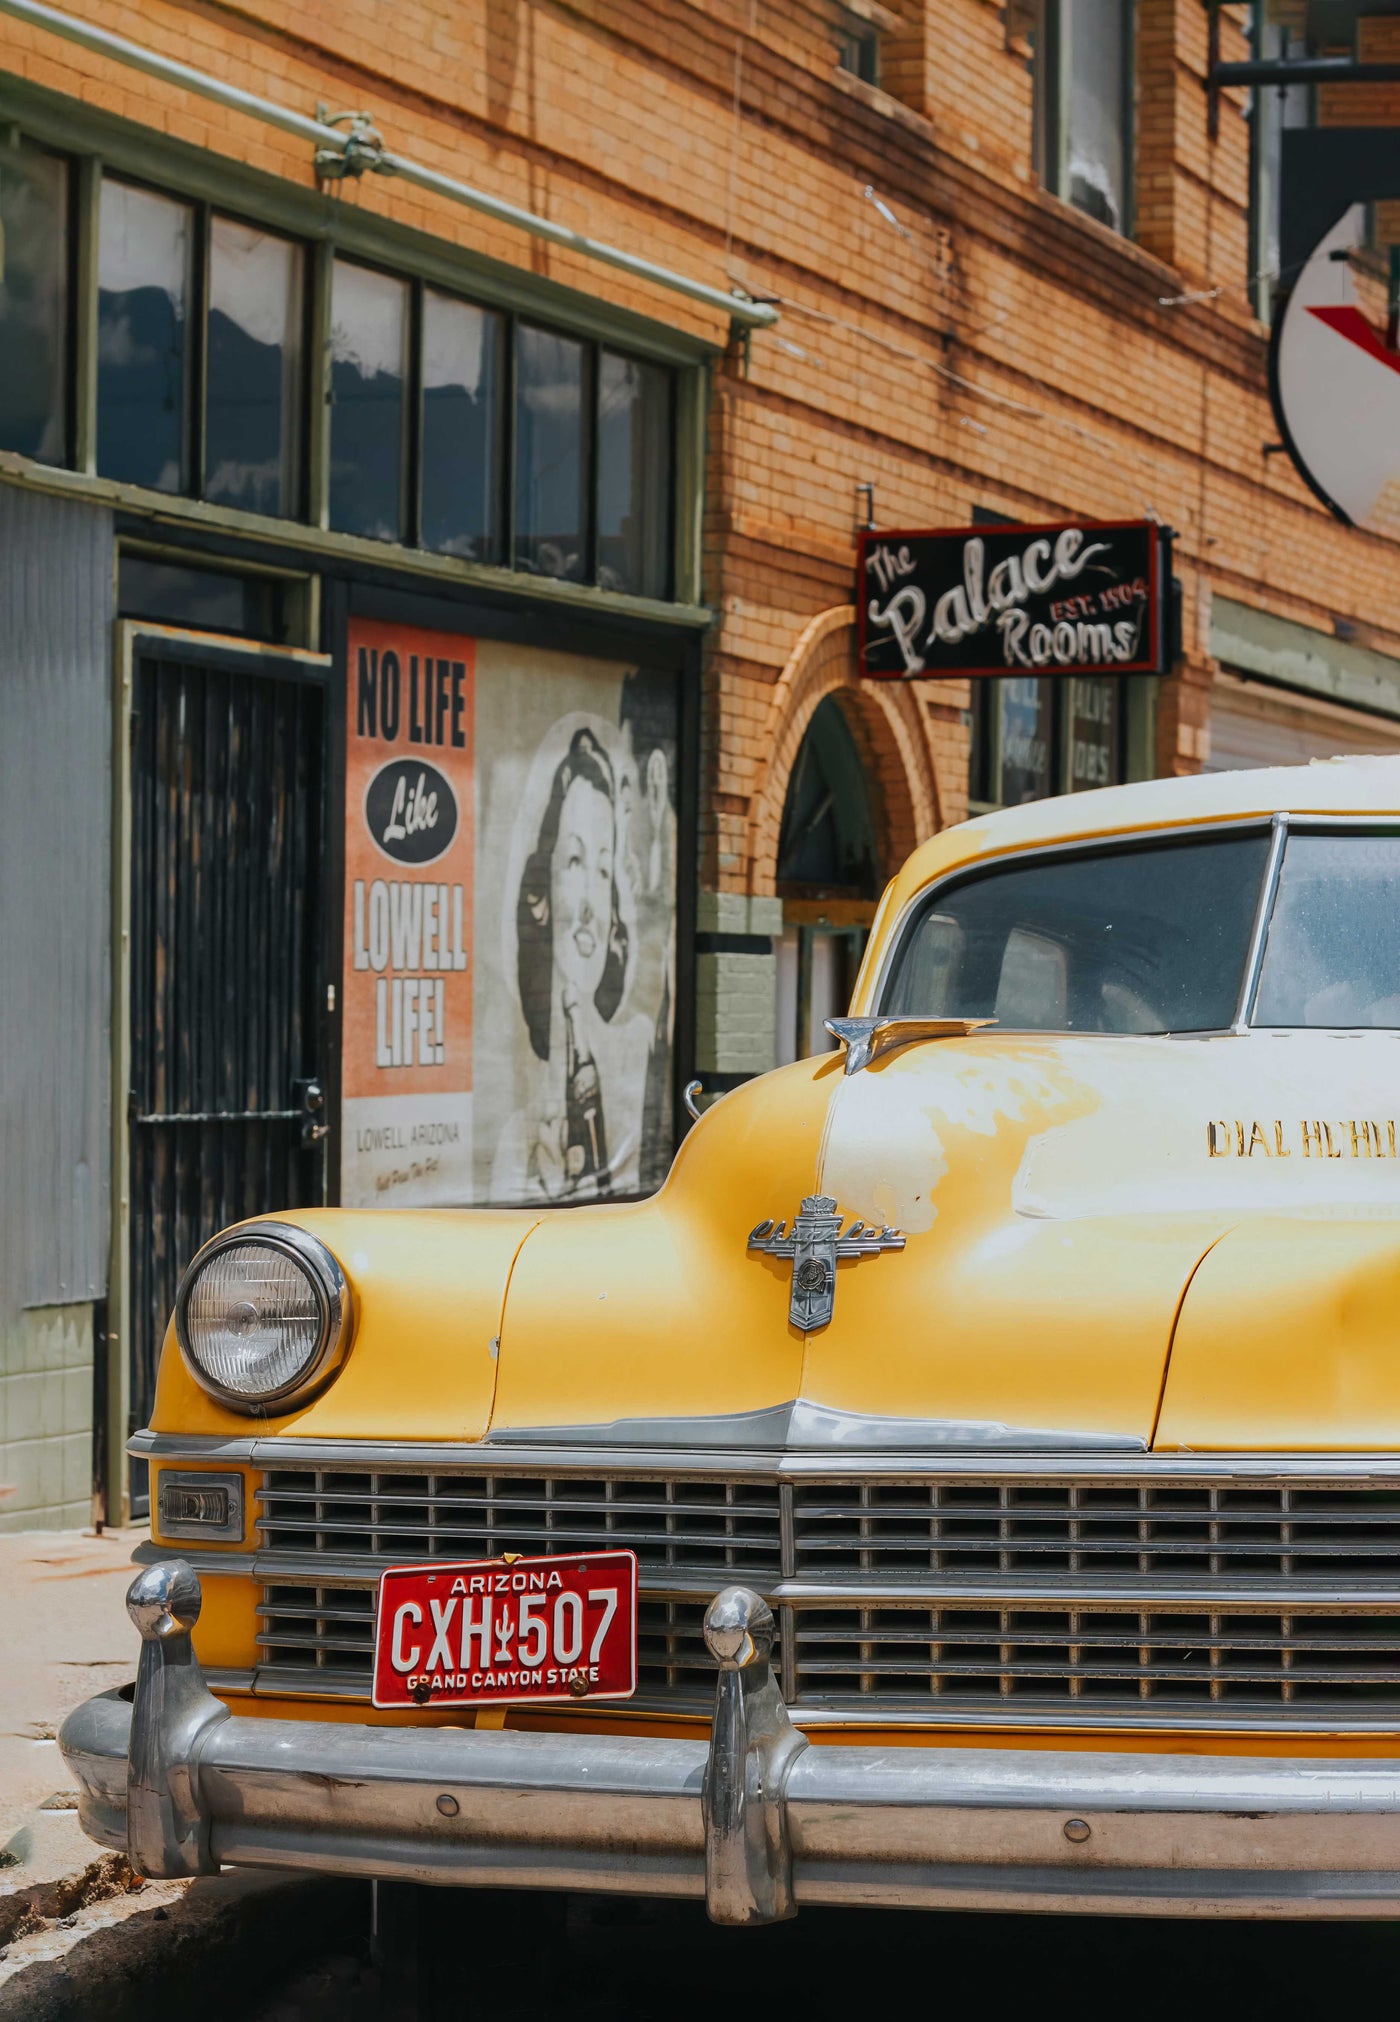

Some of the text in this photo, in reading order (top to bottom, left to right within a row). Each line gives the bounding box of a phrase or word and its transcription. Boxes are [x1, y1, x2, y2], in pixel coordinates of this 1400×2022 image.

[865, 544, 917, 592] The
[868, 528, 1113, 677] Palace
[1049, 594, 1097, 622] EST.
[996, 607, 1138, 668] Rooms
[356, 646, 466, 748] NO LIFE
[383, 772, 439, 843] Like
[353, 878, 467, 972] LOWELL
[376, 977, 444, 1068] LIFE!
[410, 1122, 459, 1146] ARIZONA
[1207, 1120, 1290, 1157] DIAL
[748, 1219, 901, 1251] Chrysler
[451, 1571, 562, 1595] ARIZONA
[391, 1588, 618, 1673] CXH 507
[407, 1667, 599, 1690] GRAND CANYON STATE
